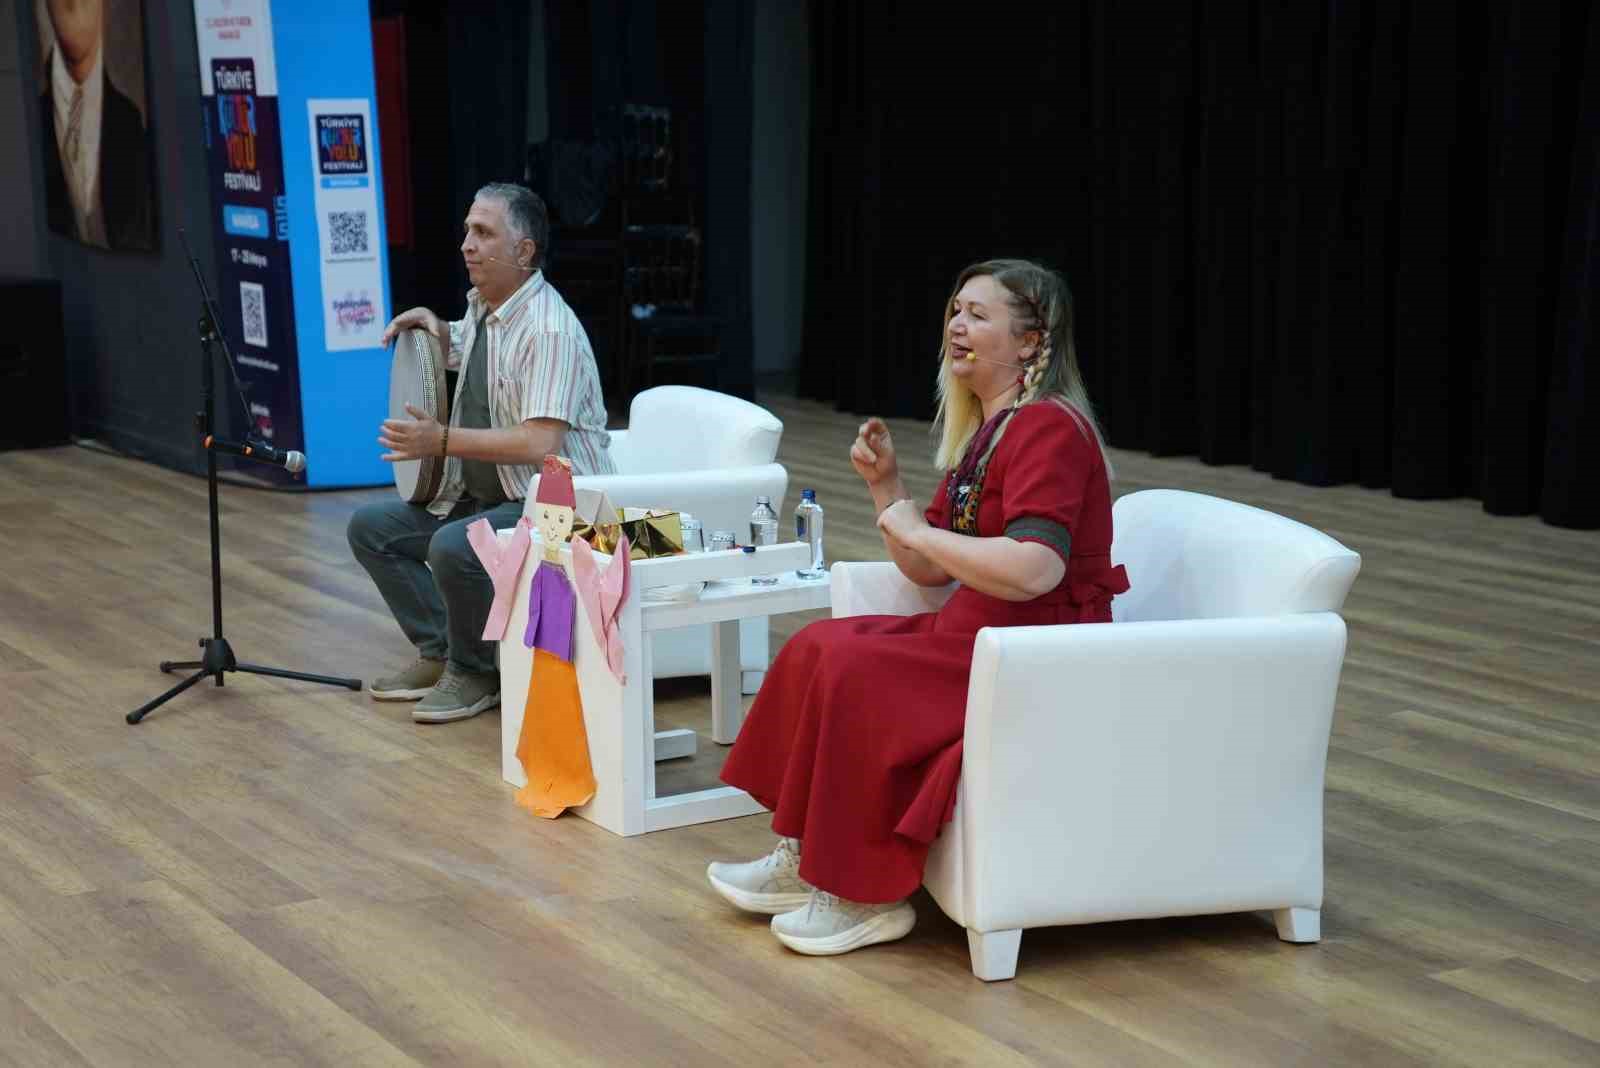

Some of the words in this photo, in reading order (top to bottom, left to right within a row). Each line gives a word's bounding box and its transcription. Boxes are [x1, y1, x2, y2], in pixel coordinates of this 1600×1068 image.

[215, 65, 253, 90] TÜRKİYE
[320, 117, 360, 128] TÜRKİYE
[223, 170, 262, 191] FESTİVALİ
